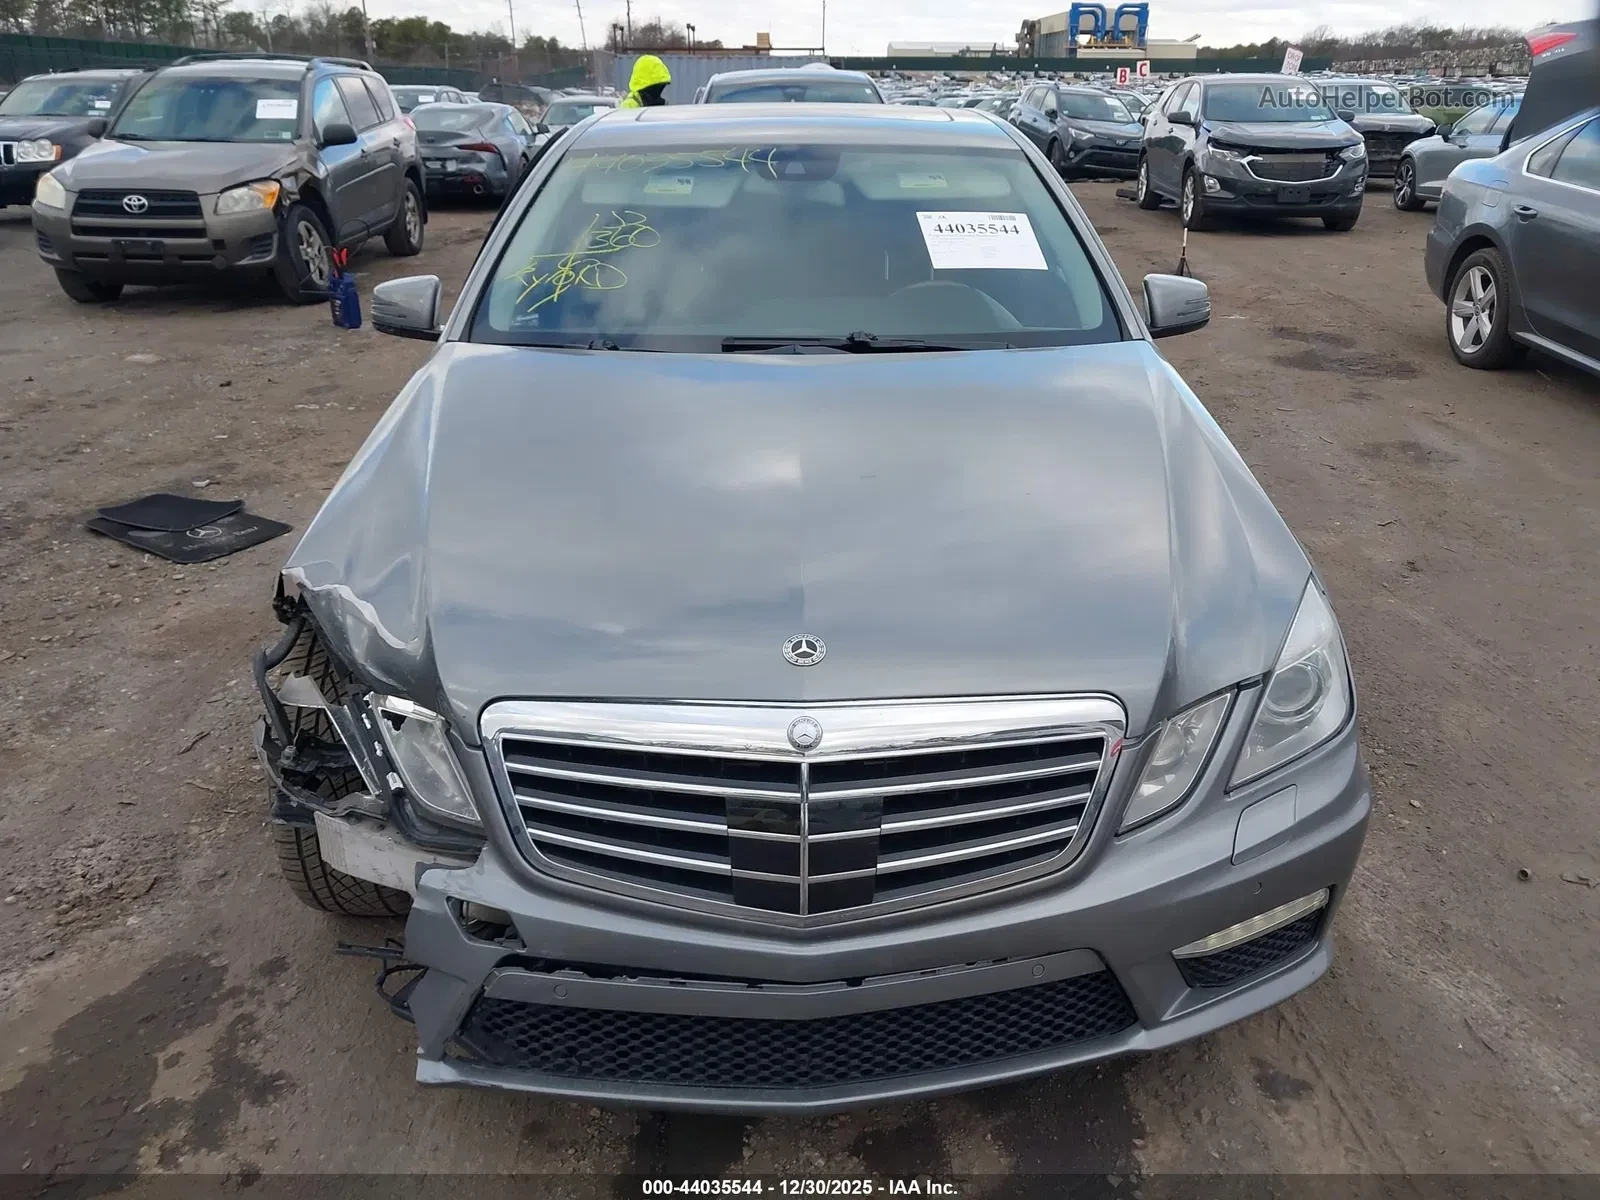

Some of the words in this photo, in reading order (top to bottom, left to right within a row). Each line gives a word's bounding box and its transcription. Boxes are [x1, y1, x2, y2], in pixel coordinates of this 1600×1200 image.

[1119, 69, 1127, 83] B
[1139, 63, 1147, 77] C
[933, 223, 1020, 235] 44035544
